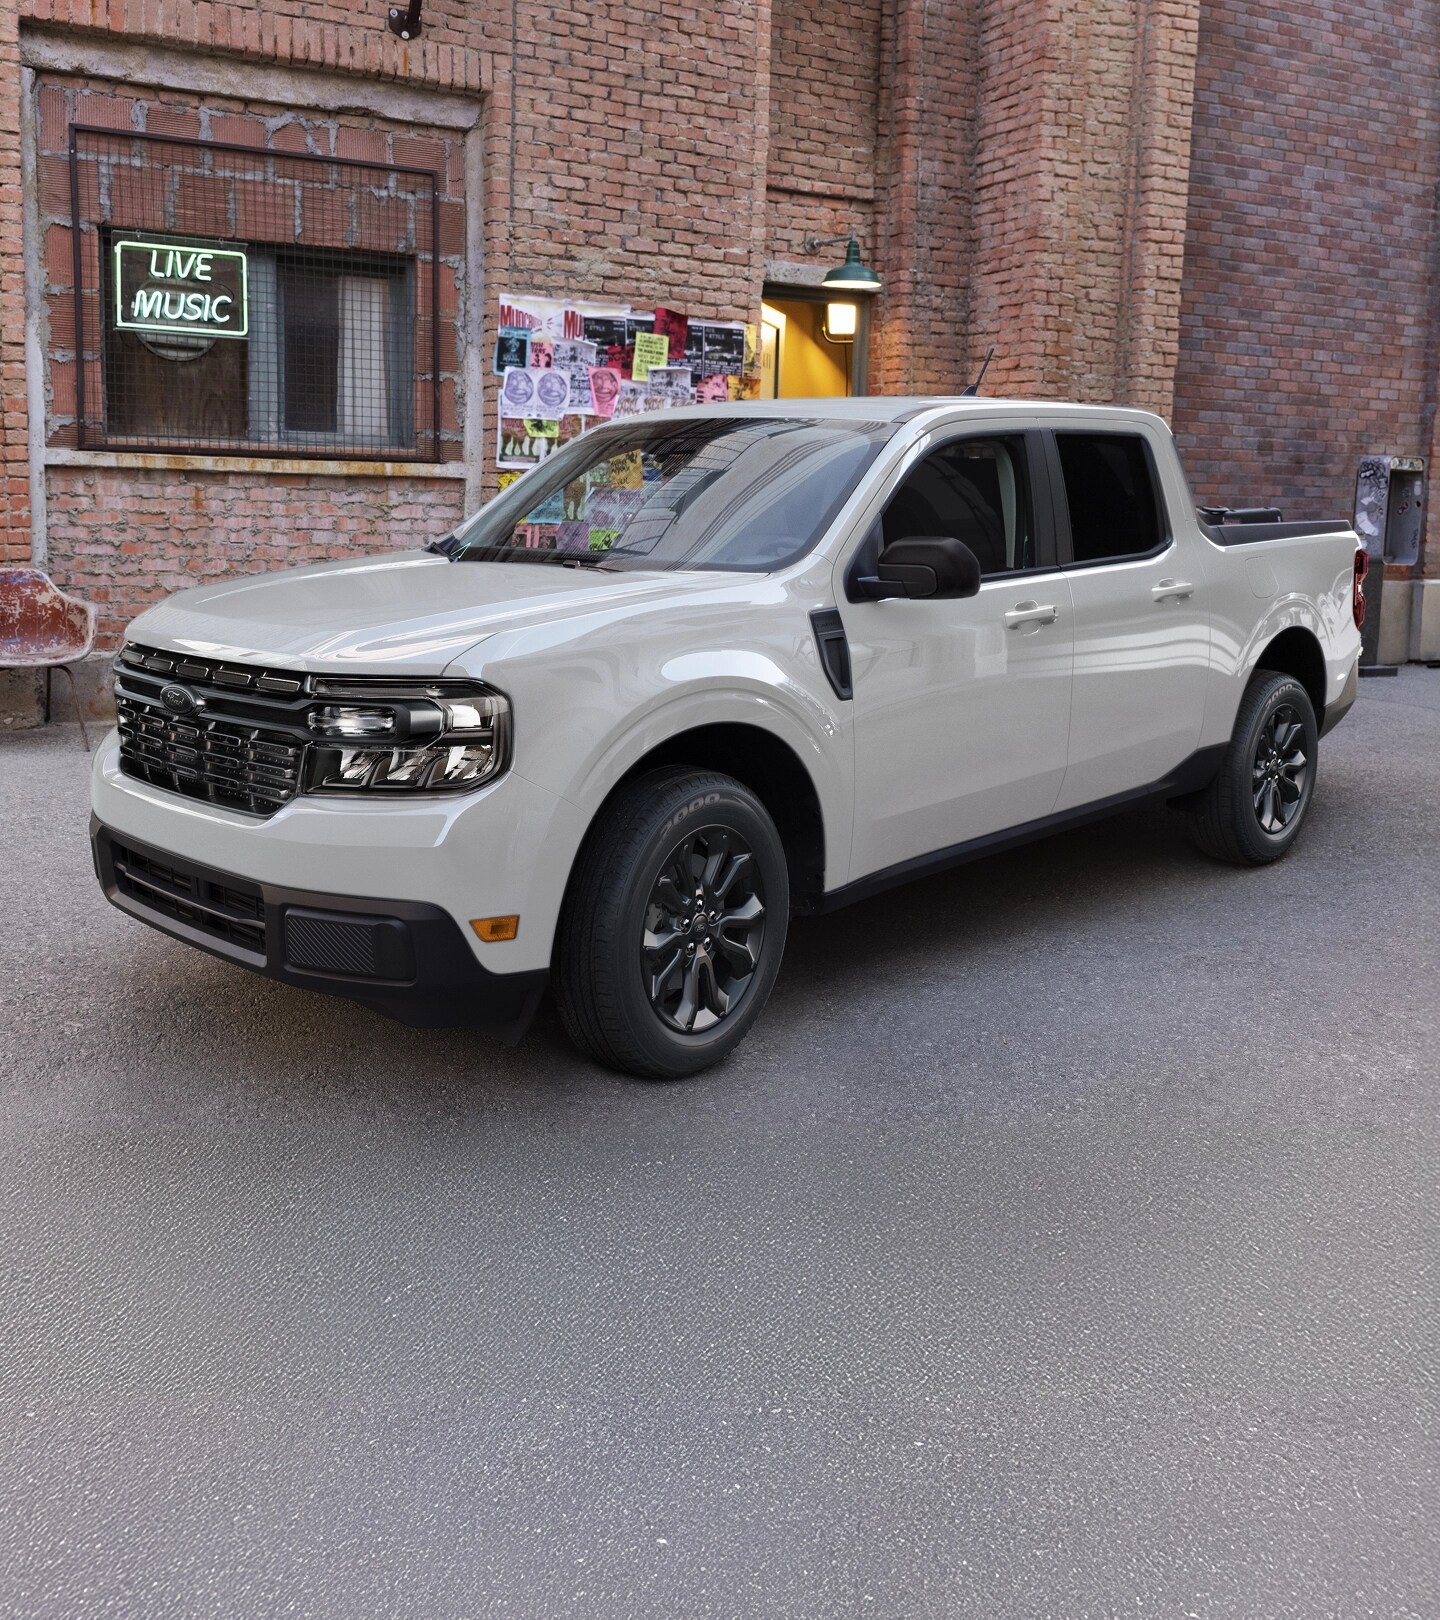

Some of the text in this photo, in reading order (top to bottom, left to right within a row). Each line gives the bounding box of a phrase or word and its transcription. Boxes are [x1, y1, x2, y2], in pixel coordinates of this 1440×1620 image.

[150, 249, 214, 281] LIVE
[133, 289, 232, 323] MUSIC
[167, 691, 185, 705] Ford
